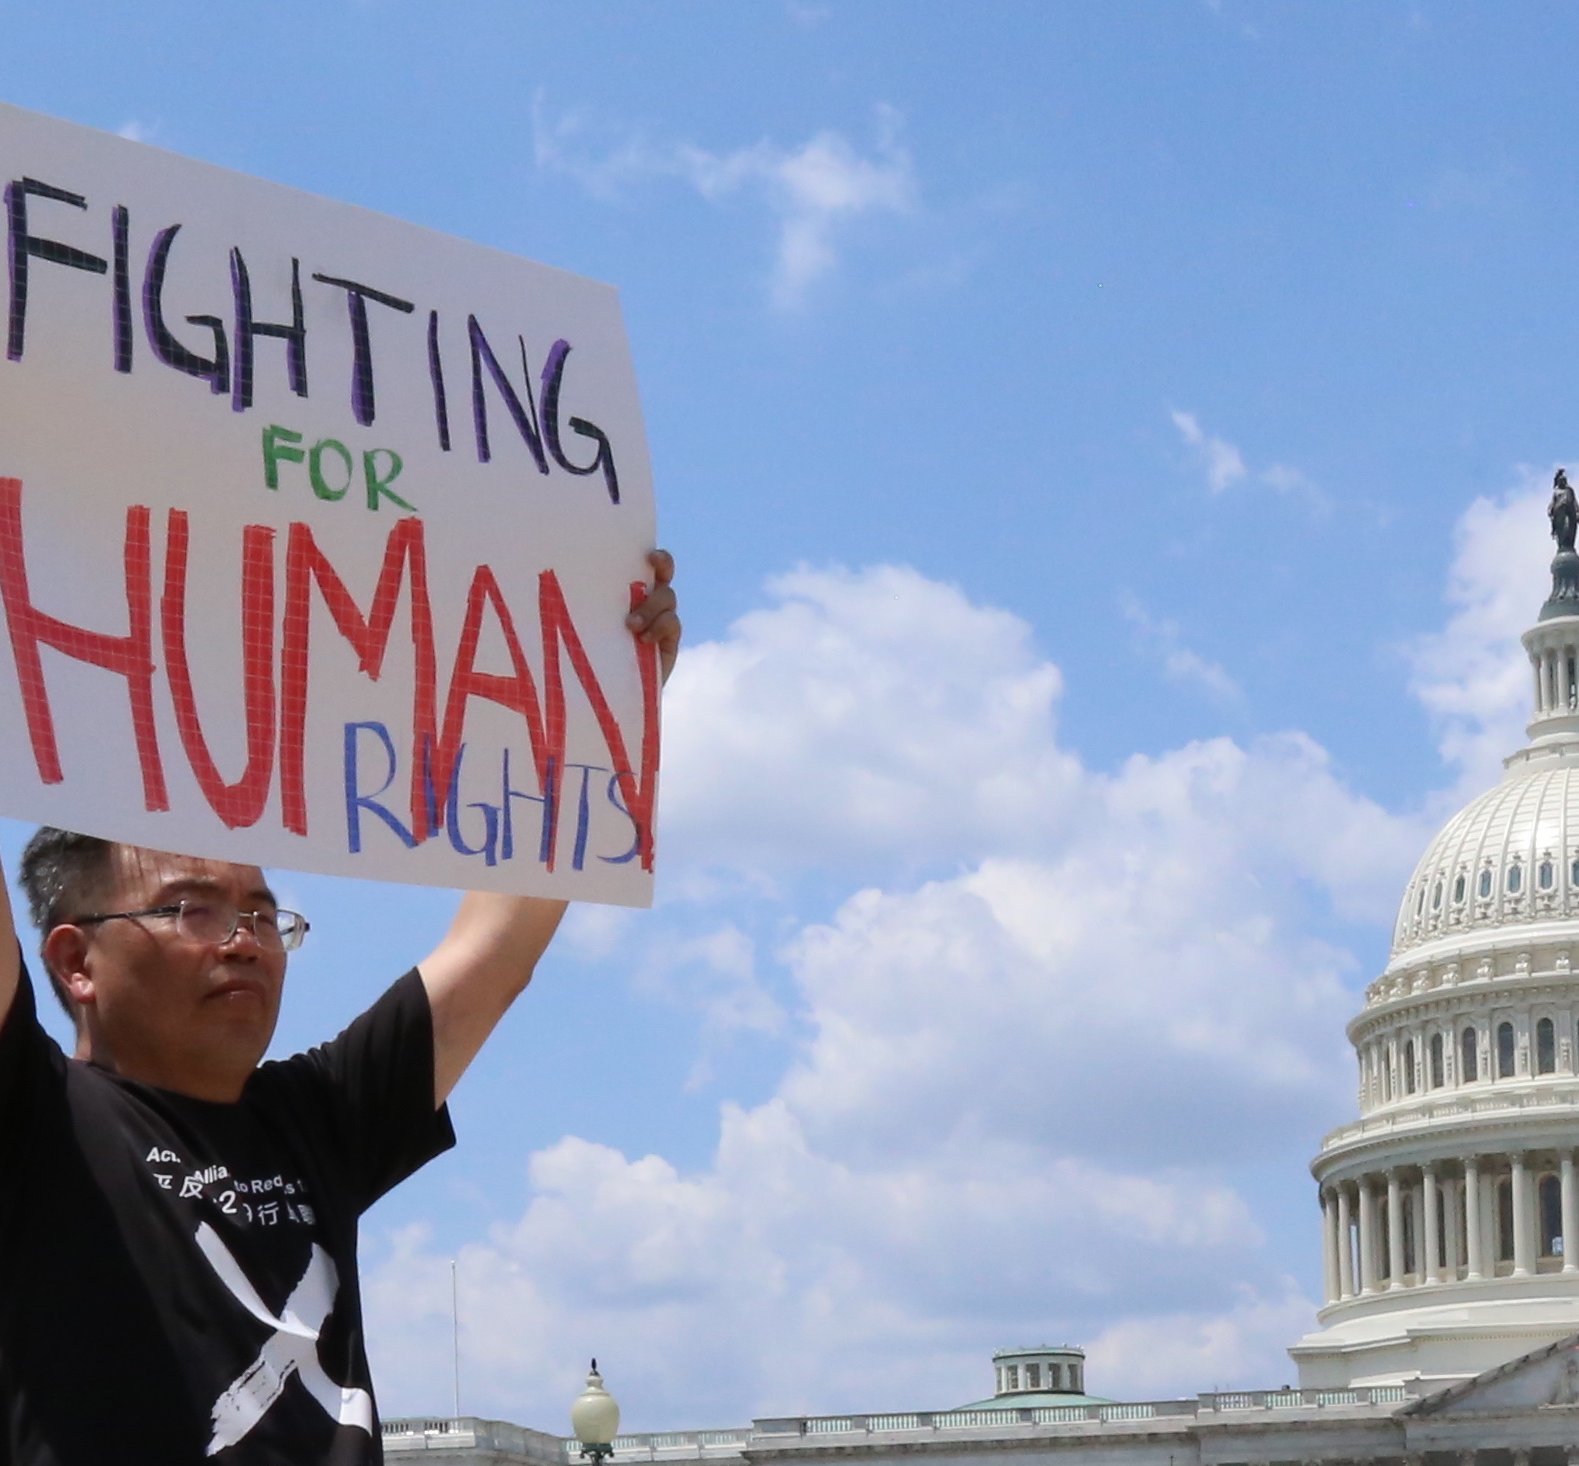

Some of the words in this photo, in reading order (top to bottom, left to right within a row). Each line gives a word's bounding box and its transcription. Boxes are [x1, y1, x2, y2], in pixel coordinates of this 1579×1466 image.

[5, 176, 620, 505] FIGHTING
[262, 424, 418, 512] FOR
[343, 721, 640, 872] RIGHTS
